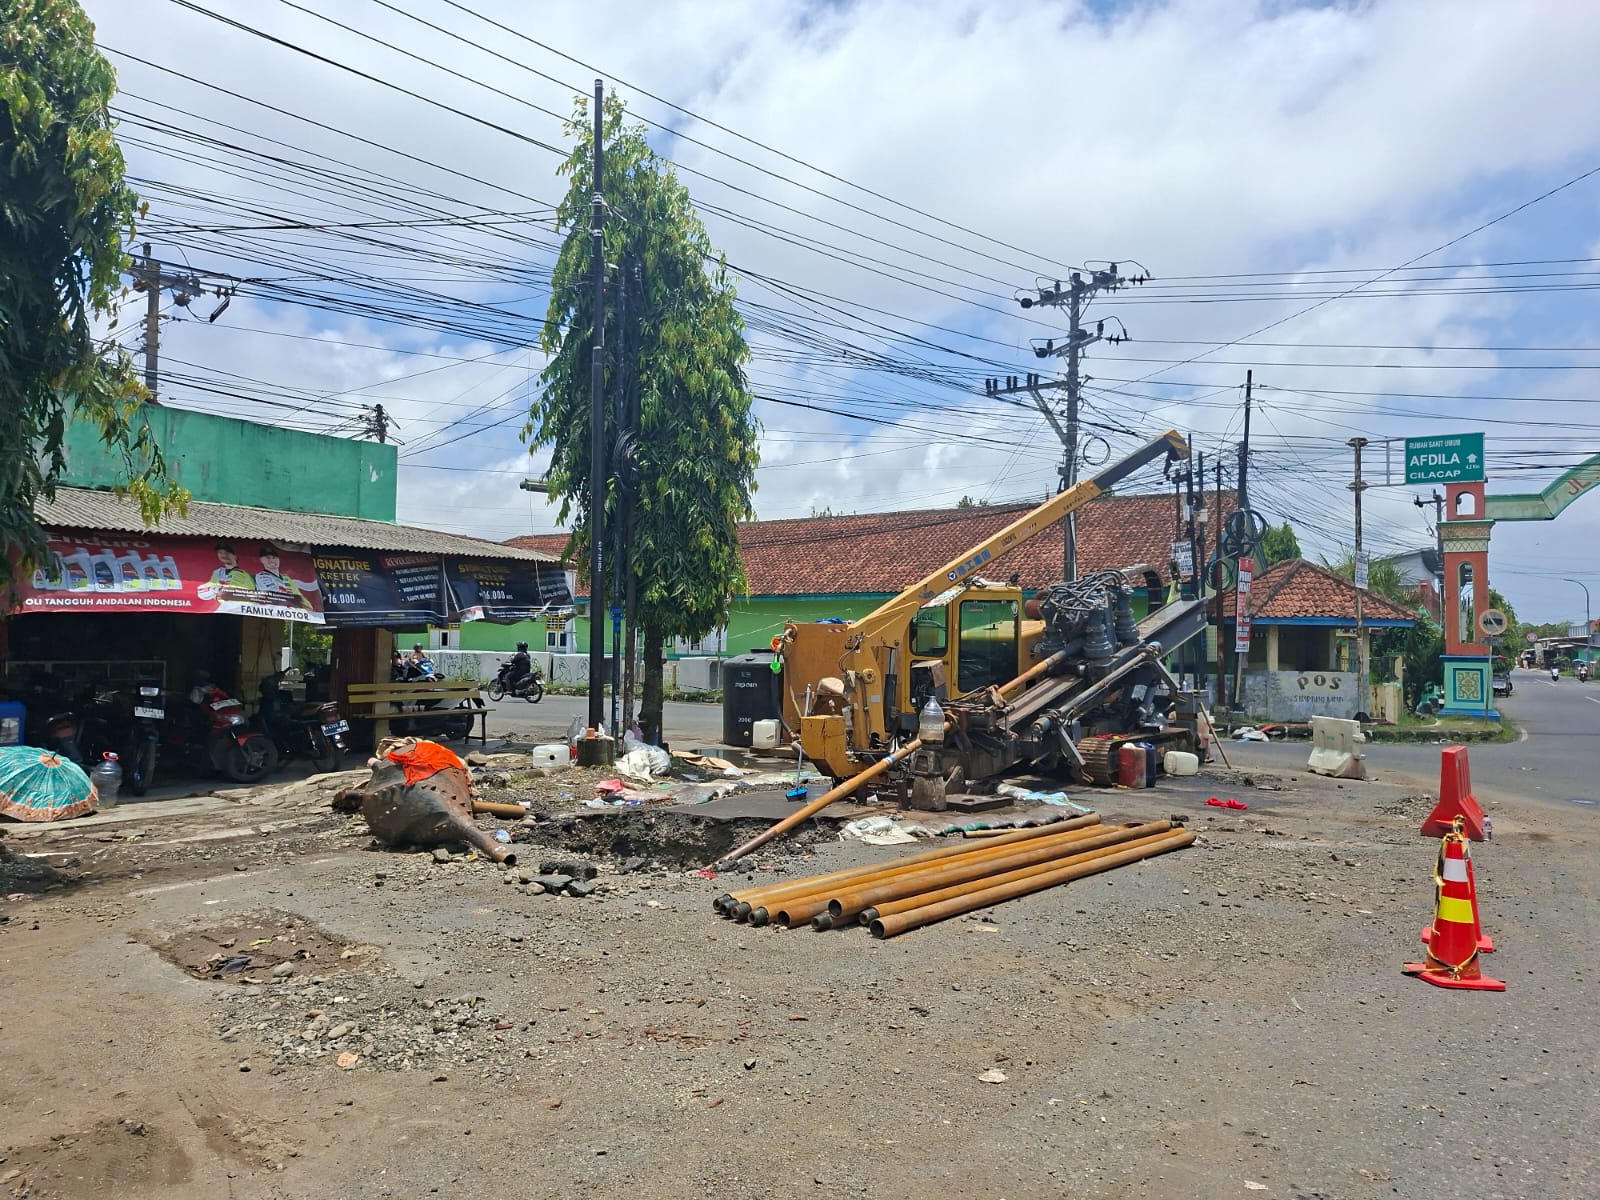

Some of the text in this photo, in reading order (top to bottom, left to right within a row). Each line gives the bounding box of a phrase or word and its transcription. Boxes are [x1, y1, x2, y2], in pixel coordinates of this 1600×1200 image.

[1409, 452, 1461, 467] AFDILA
[1409, 470, 1461, 479] CILACAP
[313, 558, 371, 571] IGNATURE
[320, 571, 360, 581] KRETEK
[44, 598, 94, 606] TANGGUH
[95, 598, 142, 606] ANDALAN
[143, 598, 192, 607] INDONESIA
[327, 593, 356, 604] 16.000
[240, 605, 274, 617] FAMILY
[276, 611, 309, 621] MOTOR
[1296, 674, 1342, 690] POS
